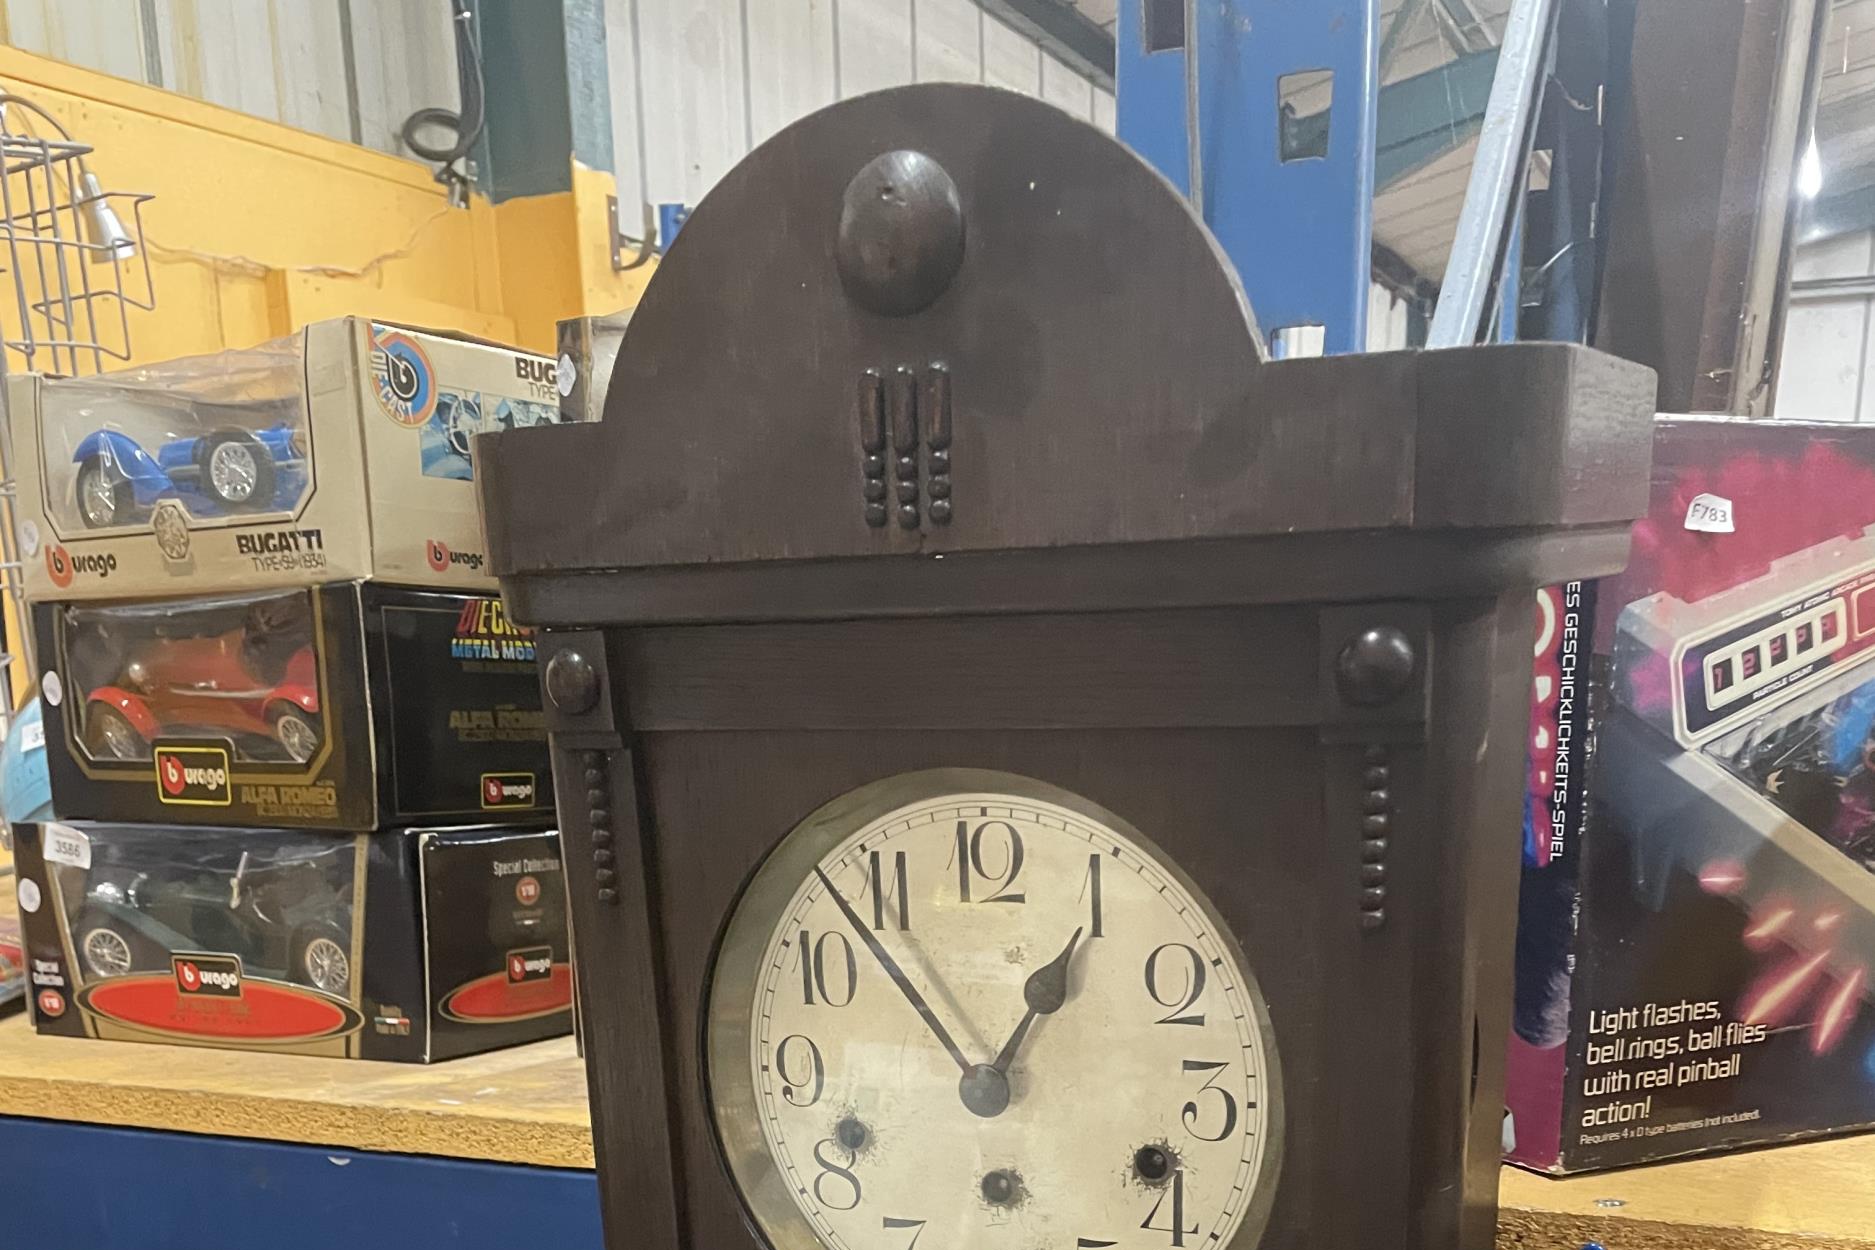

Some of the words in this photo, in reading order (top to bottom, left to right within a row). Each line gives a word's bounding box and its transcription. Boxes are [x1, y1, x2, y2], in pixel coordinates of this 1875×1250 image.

[236, 529, 323, 554] BUGATTI
[1691, 503, 1727, 522] F783
[452, 638, 499, 659] METAL
[1550, 613, 1578, 862] GESCHICKLICHKEITS-SPIEL
[859, 851, 910, 931] 11
[946, 821, 1026, 904] 12
[1078, 853, 1104, 938] 1
[793, 930, 857, 1007] 10
[1144, 943, 1206, 1026] 2
[1587, 1038, 1625, 1065] bell
[1629, 1036, 1684, 1059] rings,
[1688, 1025, 1722, 1051] ball
[1726, 1022, 1767, 1046] flies
[1589, 1006, 1639, 1035] Light
[1643, 1000, 1721, 1027] flashes,
[775, 1034, 824, 1107] 9
[1181, 1060, 1238, 1142] 3
[1583, 1069, 1630, 1096] with
[1635, 1062, 1674, 1089] real
[1678, 1053, 1741, 1087] pinball
[1580, 1130, 1620, 1145] Requires
[1622, 1127, 1628, 1138] 4
[1645, 1124, 1666, 1137] type
[1666, 1116, 1704, 1133] batteries
[1582, 1096, 1651, 1127] action!
[813, 1138, 862, 1210] 8
[1140, 1170, 1199, 1247] 4
